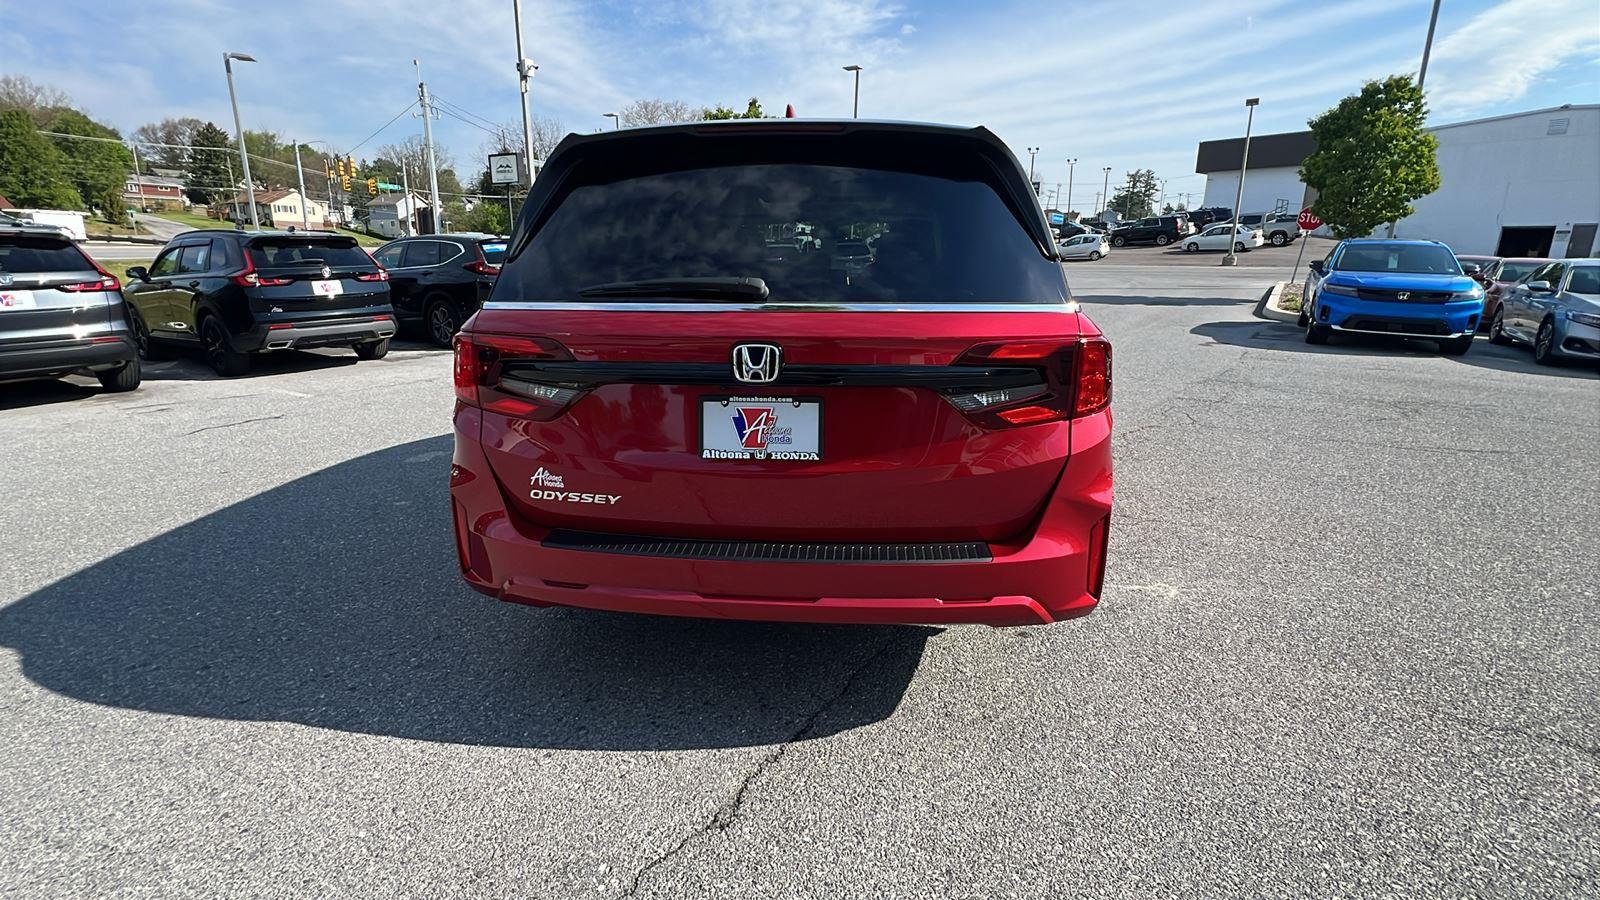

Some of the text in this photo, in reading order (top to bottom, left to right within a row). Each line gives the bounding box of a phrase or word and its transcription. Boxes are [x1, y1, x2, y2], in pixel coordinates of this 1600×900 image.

[762, 434, 792, 444] Honda
[702, 449, 750, 459] Altoona
[771, 451, 820, 461] HONDA
[531, 467, 562, 486] Altoona
[544, 479, 564, 487] Honda
[530, 490, 621, 504] ODYSSEY
